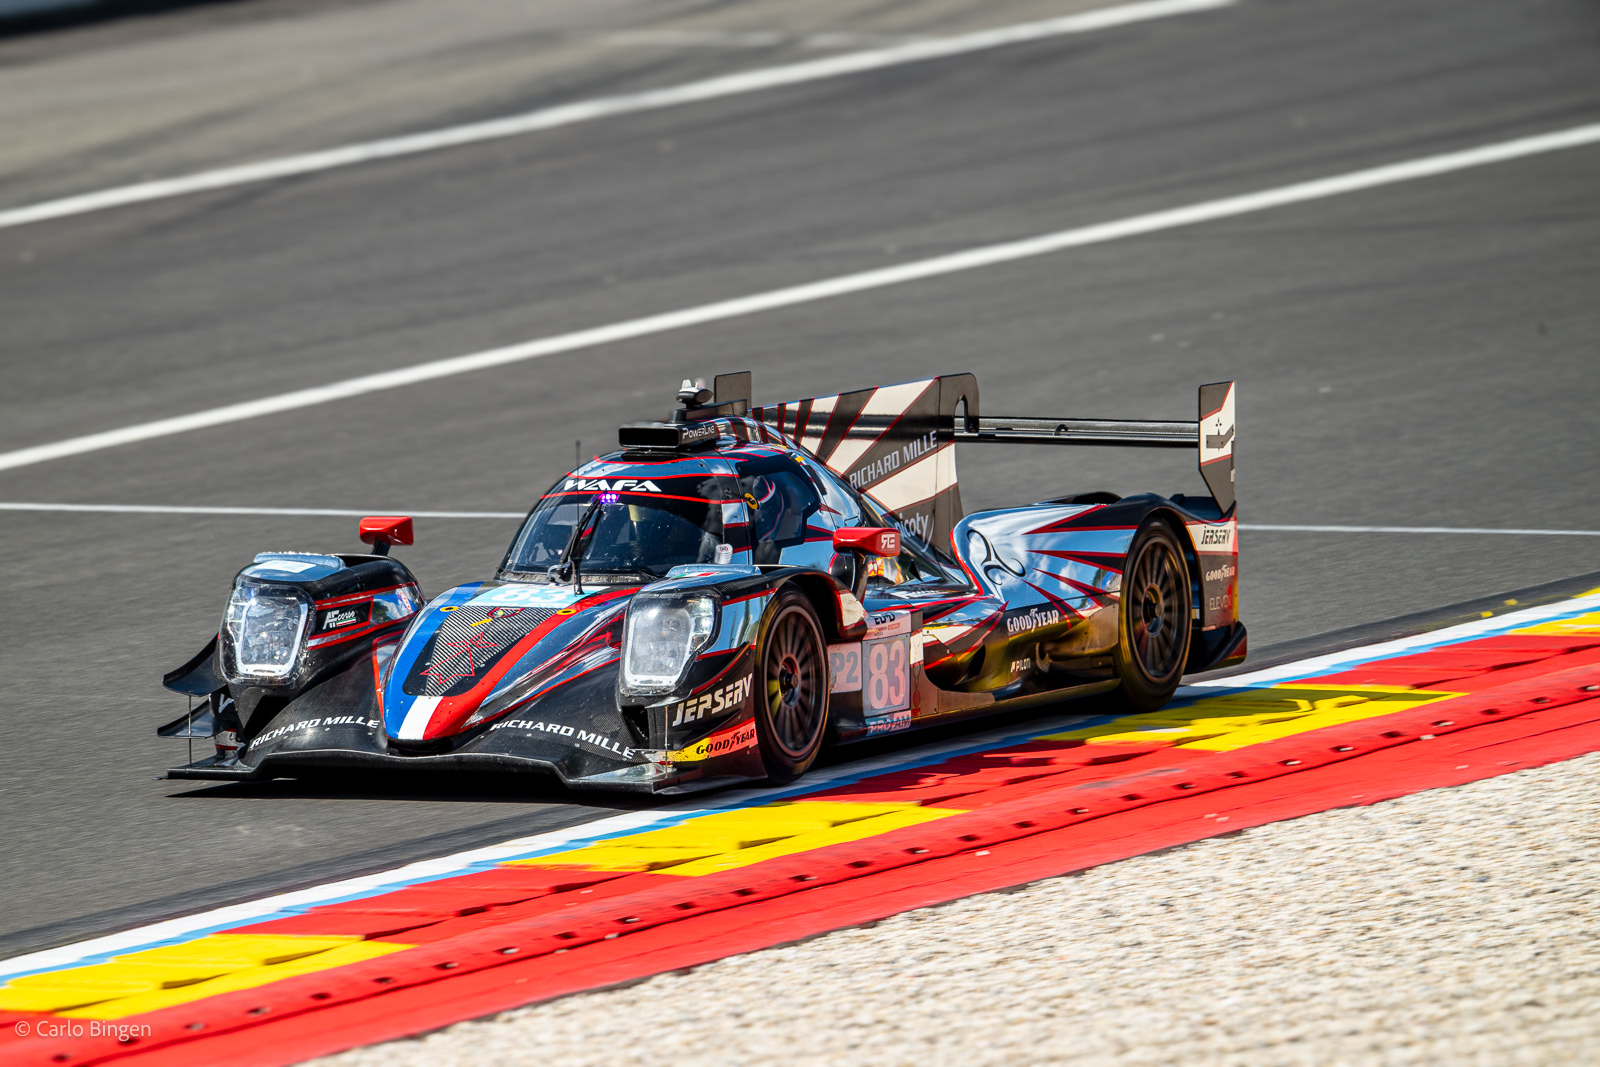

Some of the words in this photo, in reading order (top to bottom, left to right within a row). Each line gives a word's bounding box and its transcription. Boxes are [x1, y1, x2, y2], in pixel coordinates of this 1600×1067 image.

[849, 450, 900, 490] RICHARD
[902, 430, 938, 463] MILLE
[563, 479, 662, 492] WAFA
[491, 588, 568, 603] 83
[1006, 608, 1060, 633] GOODYEAR
[868, 639, 906, 710] 83
[250, 718, 322, 750] RICHARD
[322, 715, 381, 729] MILLE
[489, 719, 575, 737] RICHARD
[576, 729, 637, 760] MILLE
[695, 728, 756, 755] GOODYEAR
